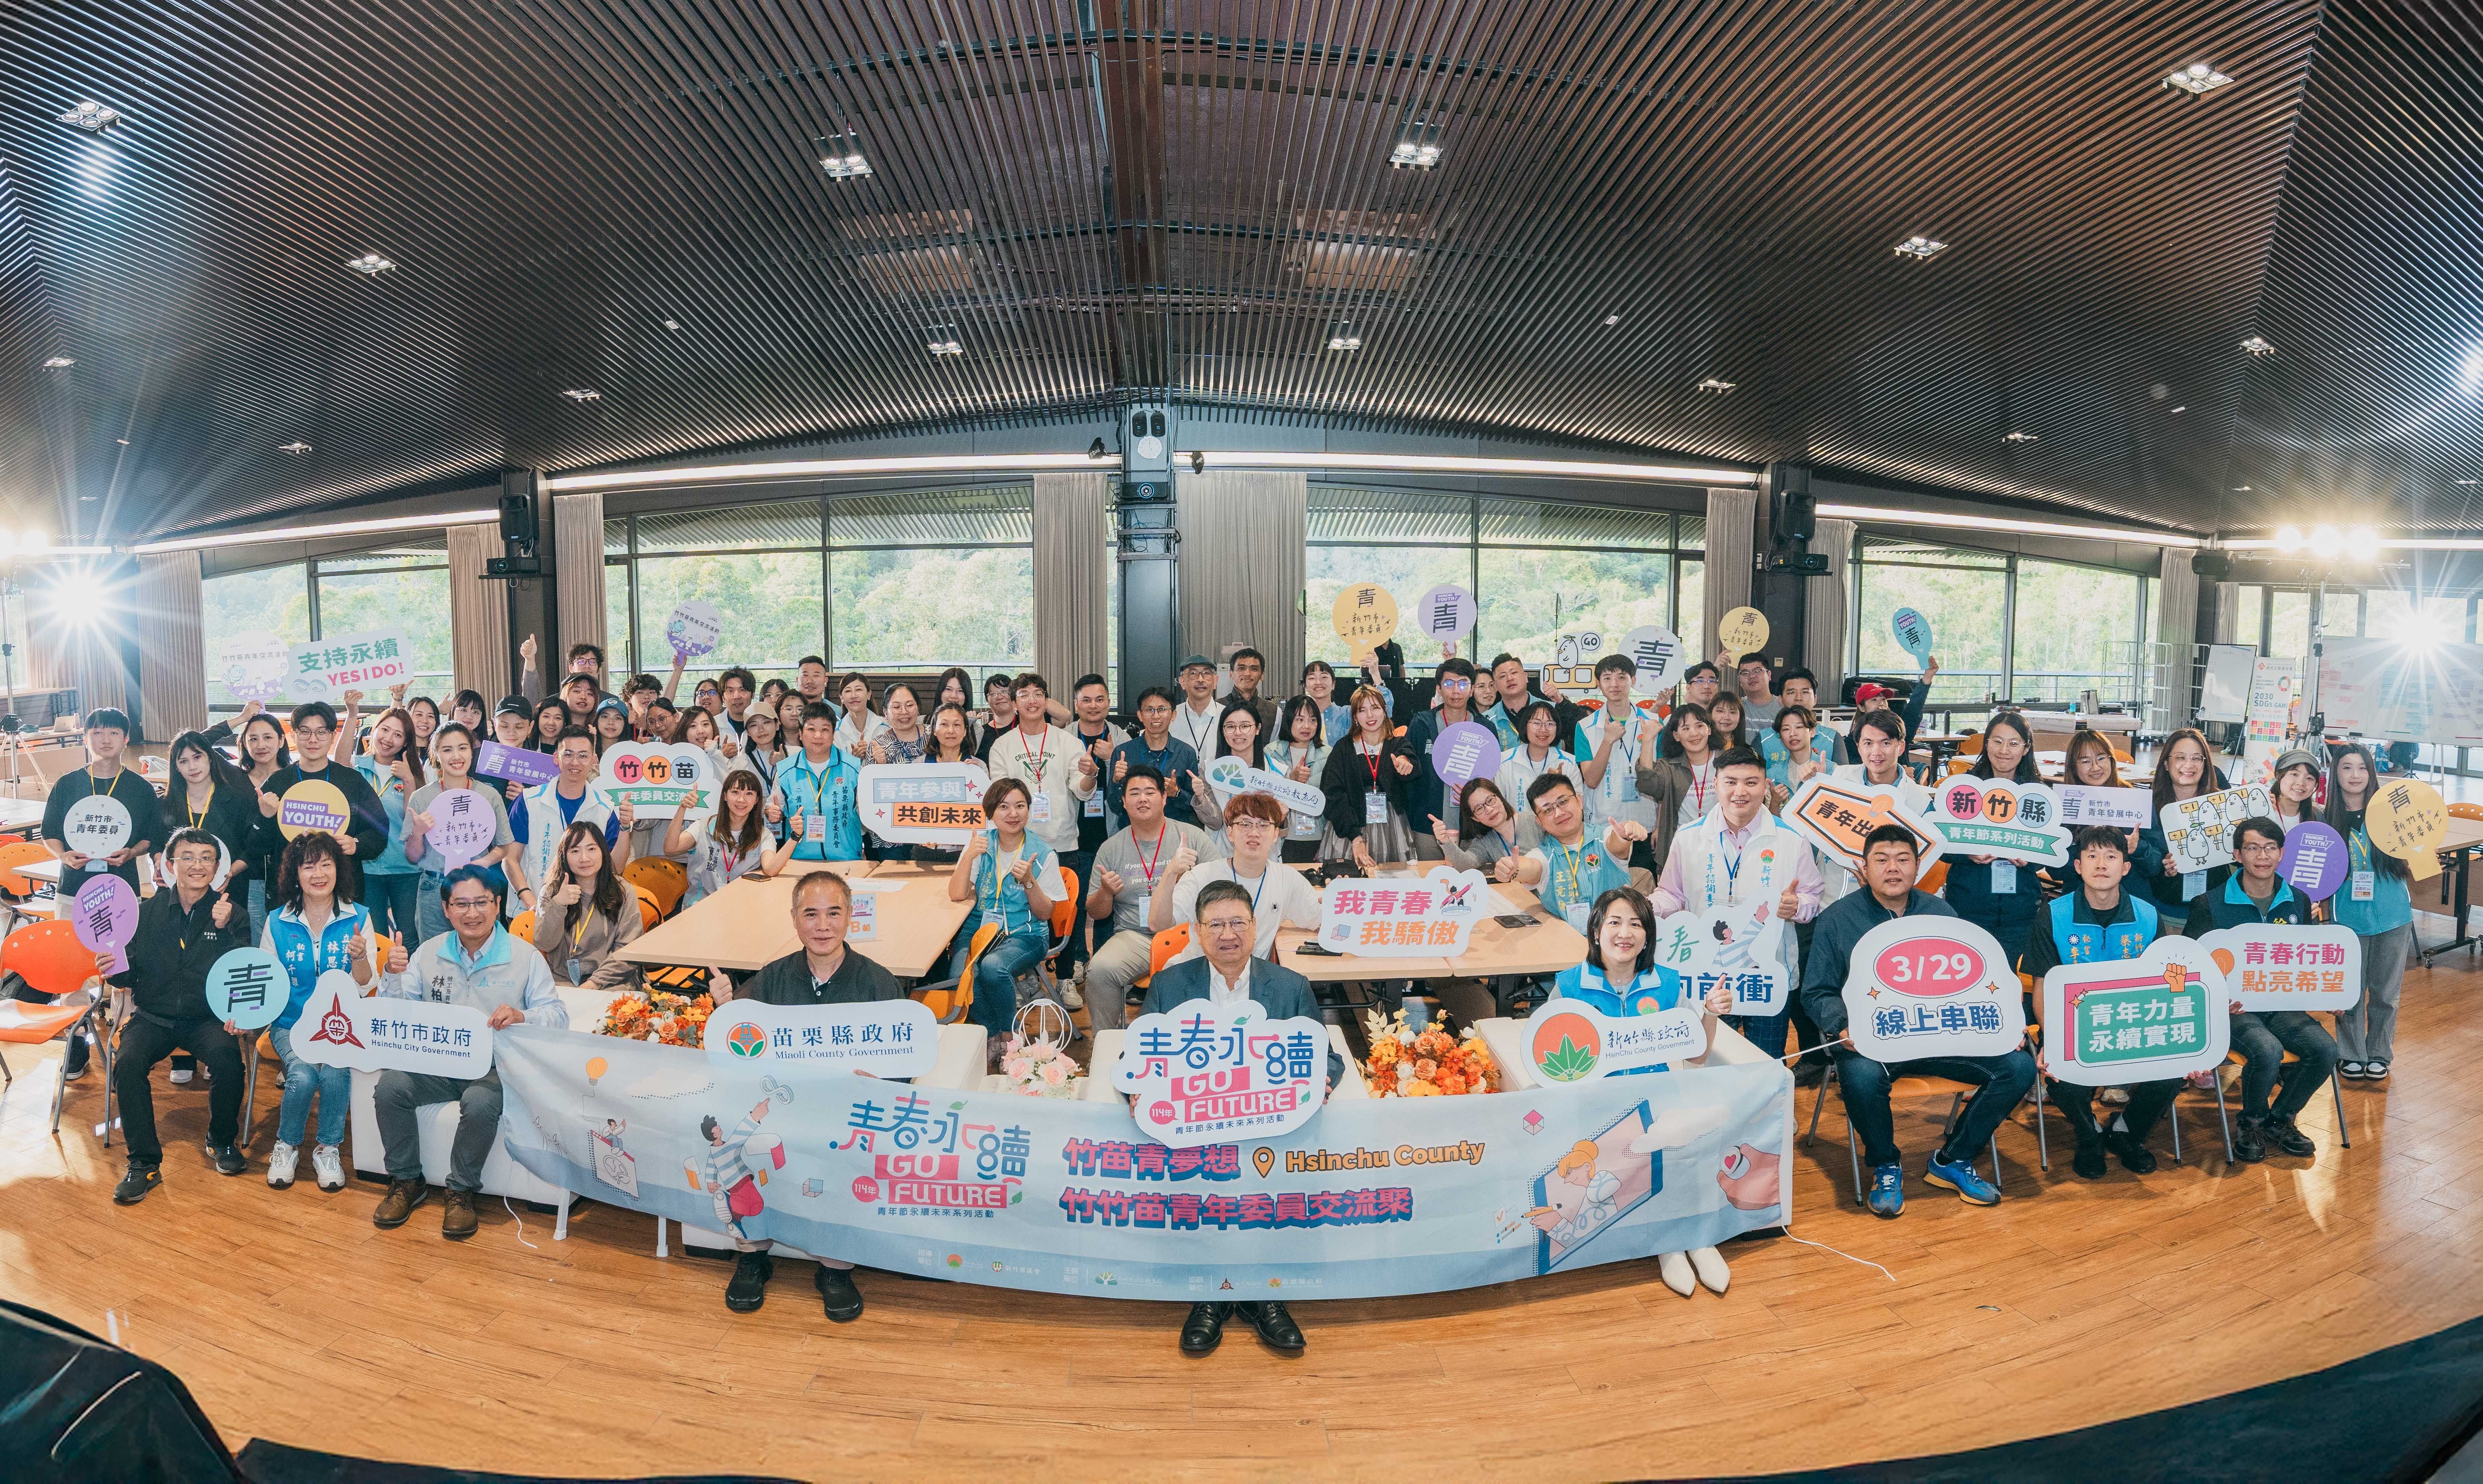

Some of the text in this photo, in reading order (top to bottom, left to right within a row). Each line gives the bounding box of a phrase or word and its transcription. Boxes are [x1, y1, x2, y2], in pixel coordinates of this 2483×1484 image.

[1357, 589, 1376, 608] 青
[1353, 612, 1378, 623] 新竹市
[1433, 604, 1457, 633] 青
[1742, 613, 1758, 625] 青
[1900, 616, 1916, 628] YOUTH!
[1352, 624, 1381, 636] 青年委員
[1905, 627, 1920, 648] 青
[1584, 637, 1597, 646] GO
[298, 638, 399, 673] 支持永續
[1633, 641, 1674, 677] 青
[327, 662, 404, 686] YES I DO!
[1461, 736, 1483, 745] YOUTH!
[484, 755, 506, 774] 青
[511, 758, 530, 768] 新竹市
[1015, 752, 1038, 761] CRITIAL
[1443, 745, 1481, 780] 青
[509, 766, 554, 781] 青年發展中心
[620, 761, 694, 778] 竹竹苗
[878, 782, 961, 799] 青年參與
[1250, 775, 1318, 805] 新竹縣政府教育局
[2387, 785, 2410, 814] 青
[286, 802, 325, 812] HSINCHU
[451, 795, 471, 816] 青
[1299, 800, 1317, 809] Government
[1952, 791, 2045, 823] 新竹縣
[2062, 798, 2081, 819] 青
[2088, 809, 2143, 819] 青年發展中心
[85, 814, 112, 823] 新竹市
[284, 811, 343, 828] YOUTH!
[446, 820, 475, 832] 新竹市
[832, 791, 840, 848] 青年事務委員會
[898, 807, 982, 826] 共創未來
[2392, 810, 2424, 832] 新竹市
[76, 824, 119, 835] 青年委員
[445, 832, 478, 845] 青年委員
[1948, 826, 2044, 849] 青年節系列活動
[2399, 821, 2434, 847] 青年委員
[1761, 866, 1772, 887] 新竹
[2290, 849, 2327, 888] 青
[82, 886, 103, 903] HSINCHU
[83, 886, 114, 912] YOUTH!
[1333, 890, 1432, 915] 我青春
[89, 905, 113, 943] 青
[1360, 921, 1459, 946] 我驕傲
[327, 941, 340, 968] 林思
[2244, 942, 2345, 965] 青春行動
[1892, 953, 1971, 982] 3/29
[224, 963, 273, 1013] 青
[432, 975, 444, 1001] 林柏
[2243, 970, 2344, 992] 點亮希望
[1875, 1004, 2000, 1036] 線上串聯
[2089, 996, 2195, 1027] 青年力量
[371, 1018, 471, 1047] 新竹市政府
[772, 1022, 913, 1047] 苗栗縣政府
[1608, 1021, 1689, 1049] 新竹縣政府
[2089, 1023, 2196, 1054] 永續實現
[372, 1040, 470, 1058] Hsinchu City Government
[775, 1046, 914, 1059] Miaoli County Government
[1127, 1013, 1313, 1085] 青春永續
[1658, 1039, 1694, 1050] Government
[1183, 1068, 1232, 1096] GO
[1152, 1108, 1172, 1117] 114年
[1191, 1089, 1291, 1121] FUTURE
[1175, 1114, 1284, 1135] 青年節永續未來系列活動
[830, 1091, 1031, 1185] 青春永續
[886, 1154, 940, 1178] GO
[1063, 1137, 1485, 1181] 竹苗青夢想 Hsinchu County
[854, 1183, 877, 1196] 114年
[895, 1183, 1001, 1206] FUTURE
[877, 1206, 993, 1218] 青年節永續未來系列活動
[1060, 1187, 1412, 1230] 竹竹苗青年委員交流聚
